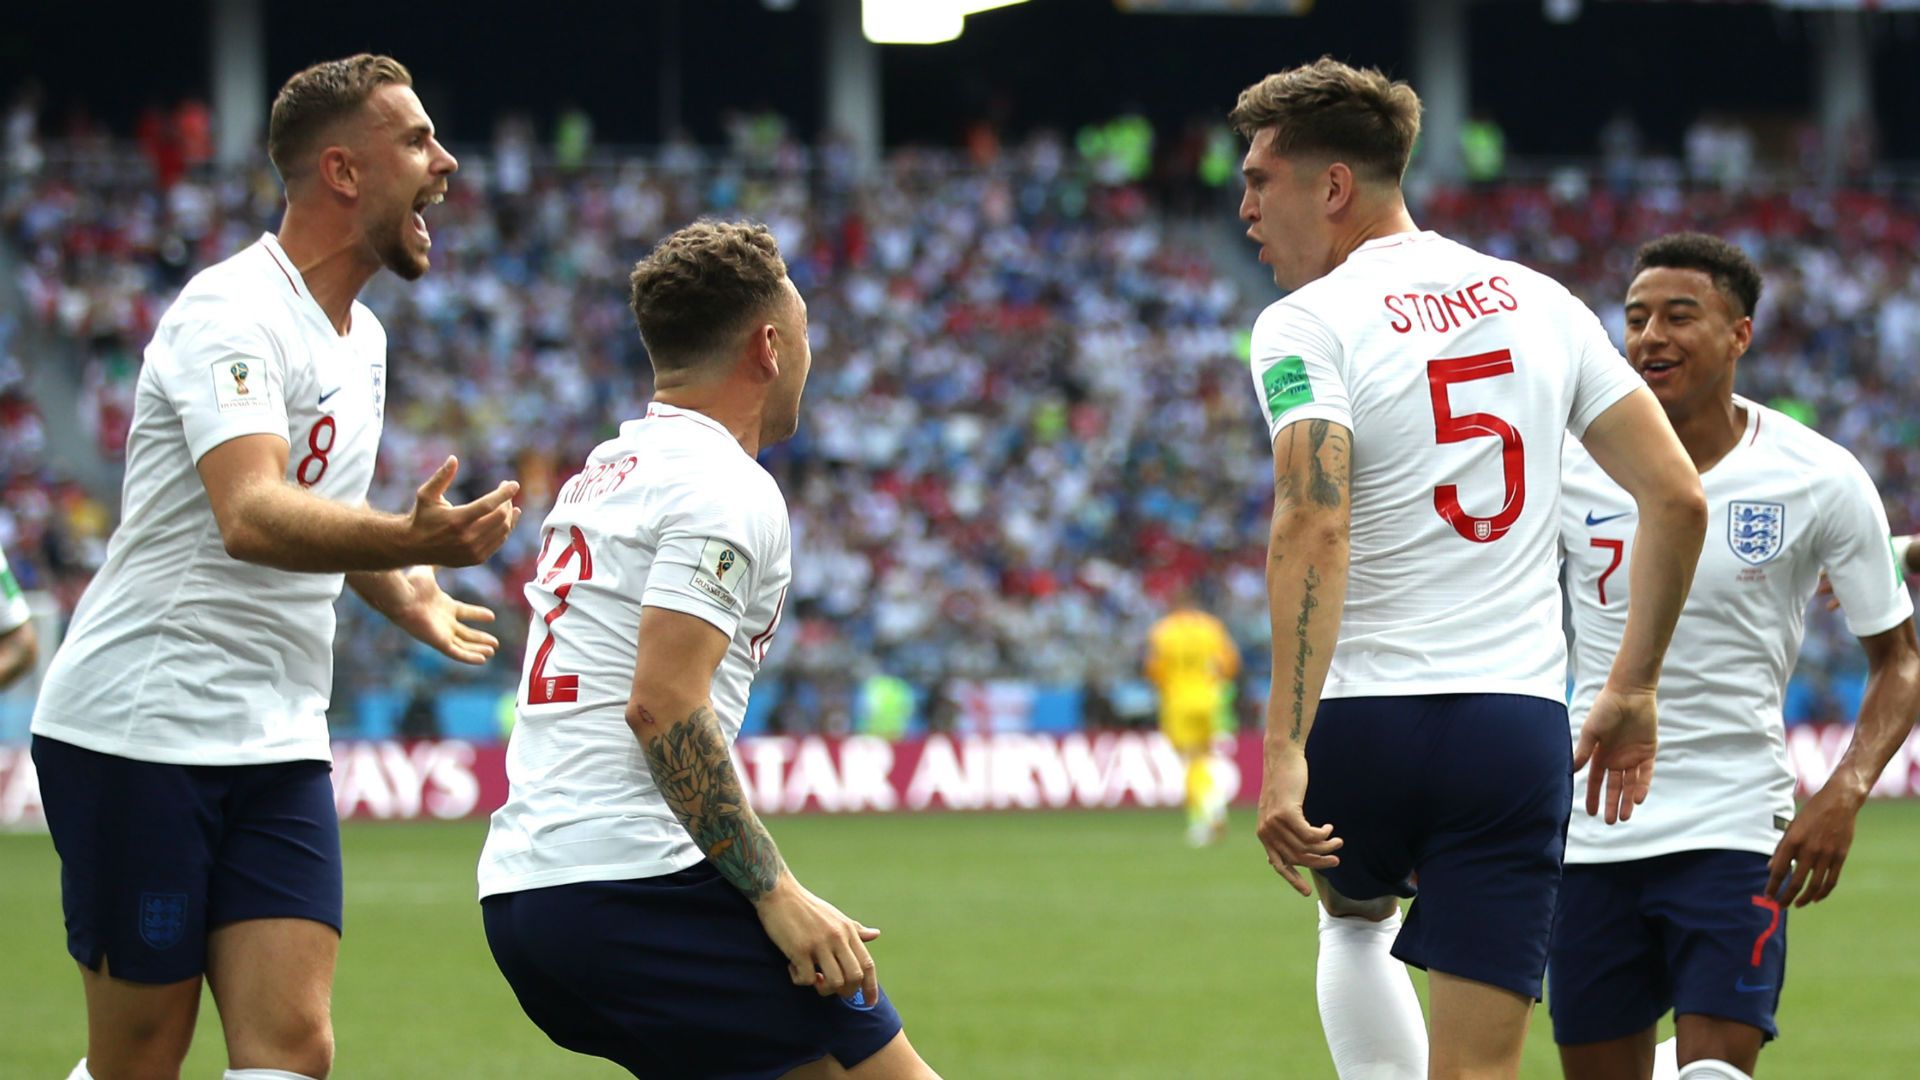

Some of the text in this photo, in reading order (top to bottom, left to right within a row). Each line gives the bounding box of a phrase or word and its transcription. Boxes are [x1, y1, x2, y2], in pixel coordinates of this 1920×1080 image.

[1384, 275, 1518, 334] STONES
[296, 415, 336, 489] 8
[1427, 348, 1525, 544] 5
[1590, 538, 1624, 606] 7
[1751, 895, 1780, 968] 7
